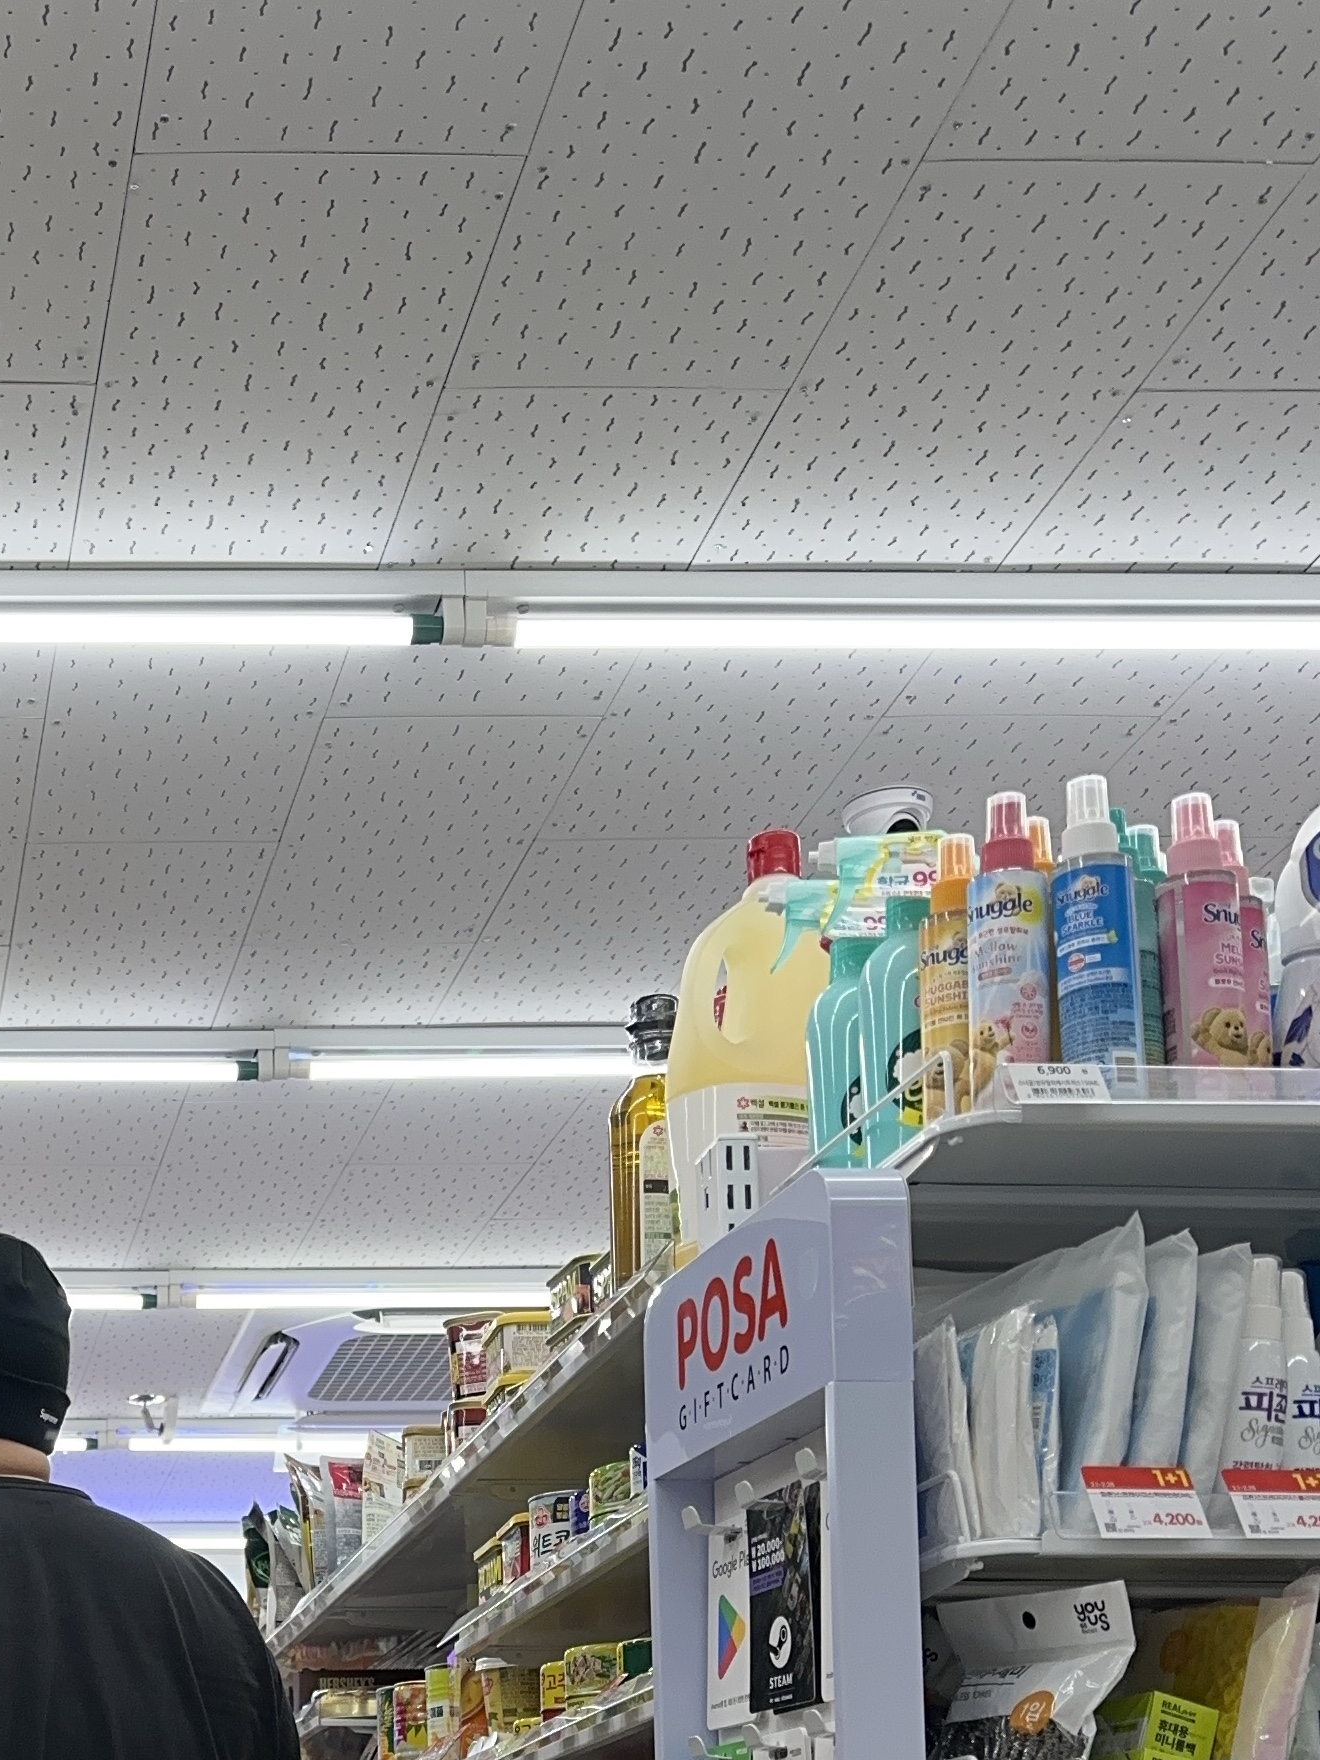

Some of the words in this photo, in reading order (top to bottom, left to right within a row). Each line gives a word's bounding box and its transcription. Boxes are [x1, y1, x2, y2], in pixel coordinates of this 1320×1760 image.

[1037, 1065, 1071, 1076] 6,900
[677, 1237, 788, 1391] POSA
[1152, 1469, 1190, 1488] 1+1
[712, 1555, 737, 1579] Google
[319, 1676, 375, 1690] HERSHEY'S
[769, 1672, 793, 1690] STEAM
[1157, 1719, 1189, 1738] 휴대용
